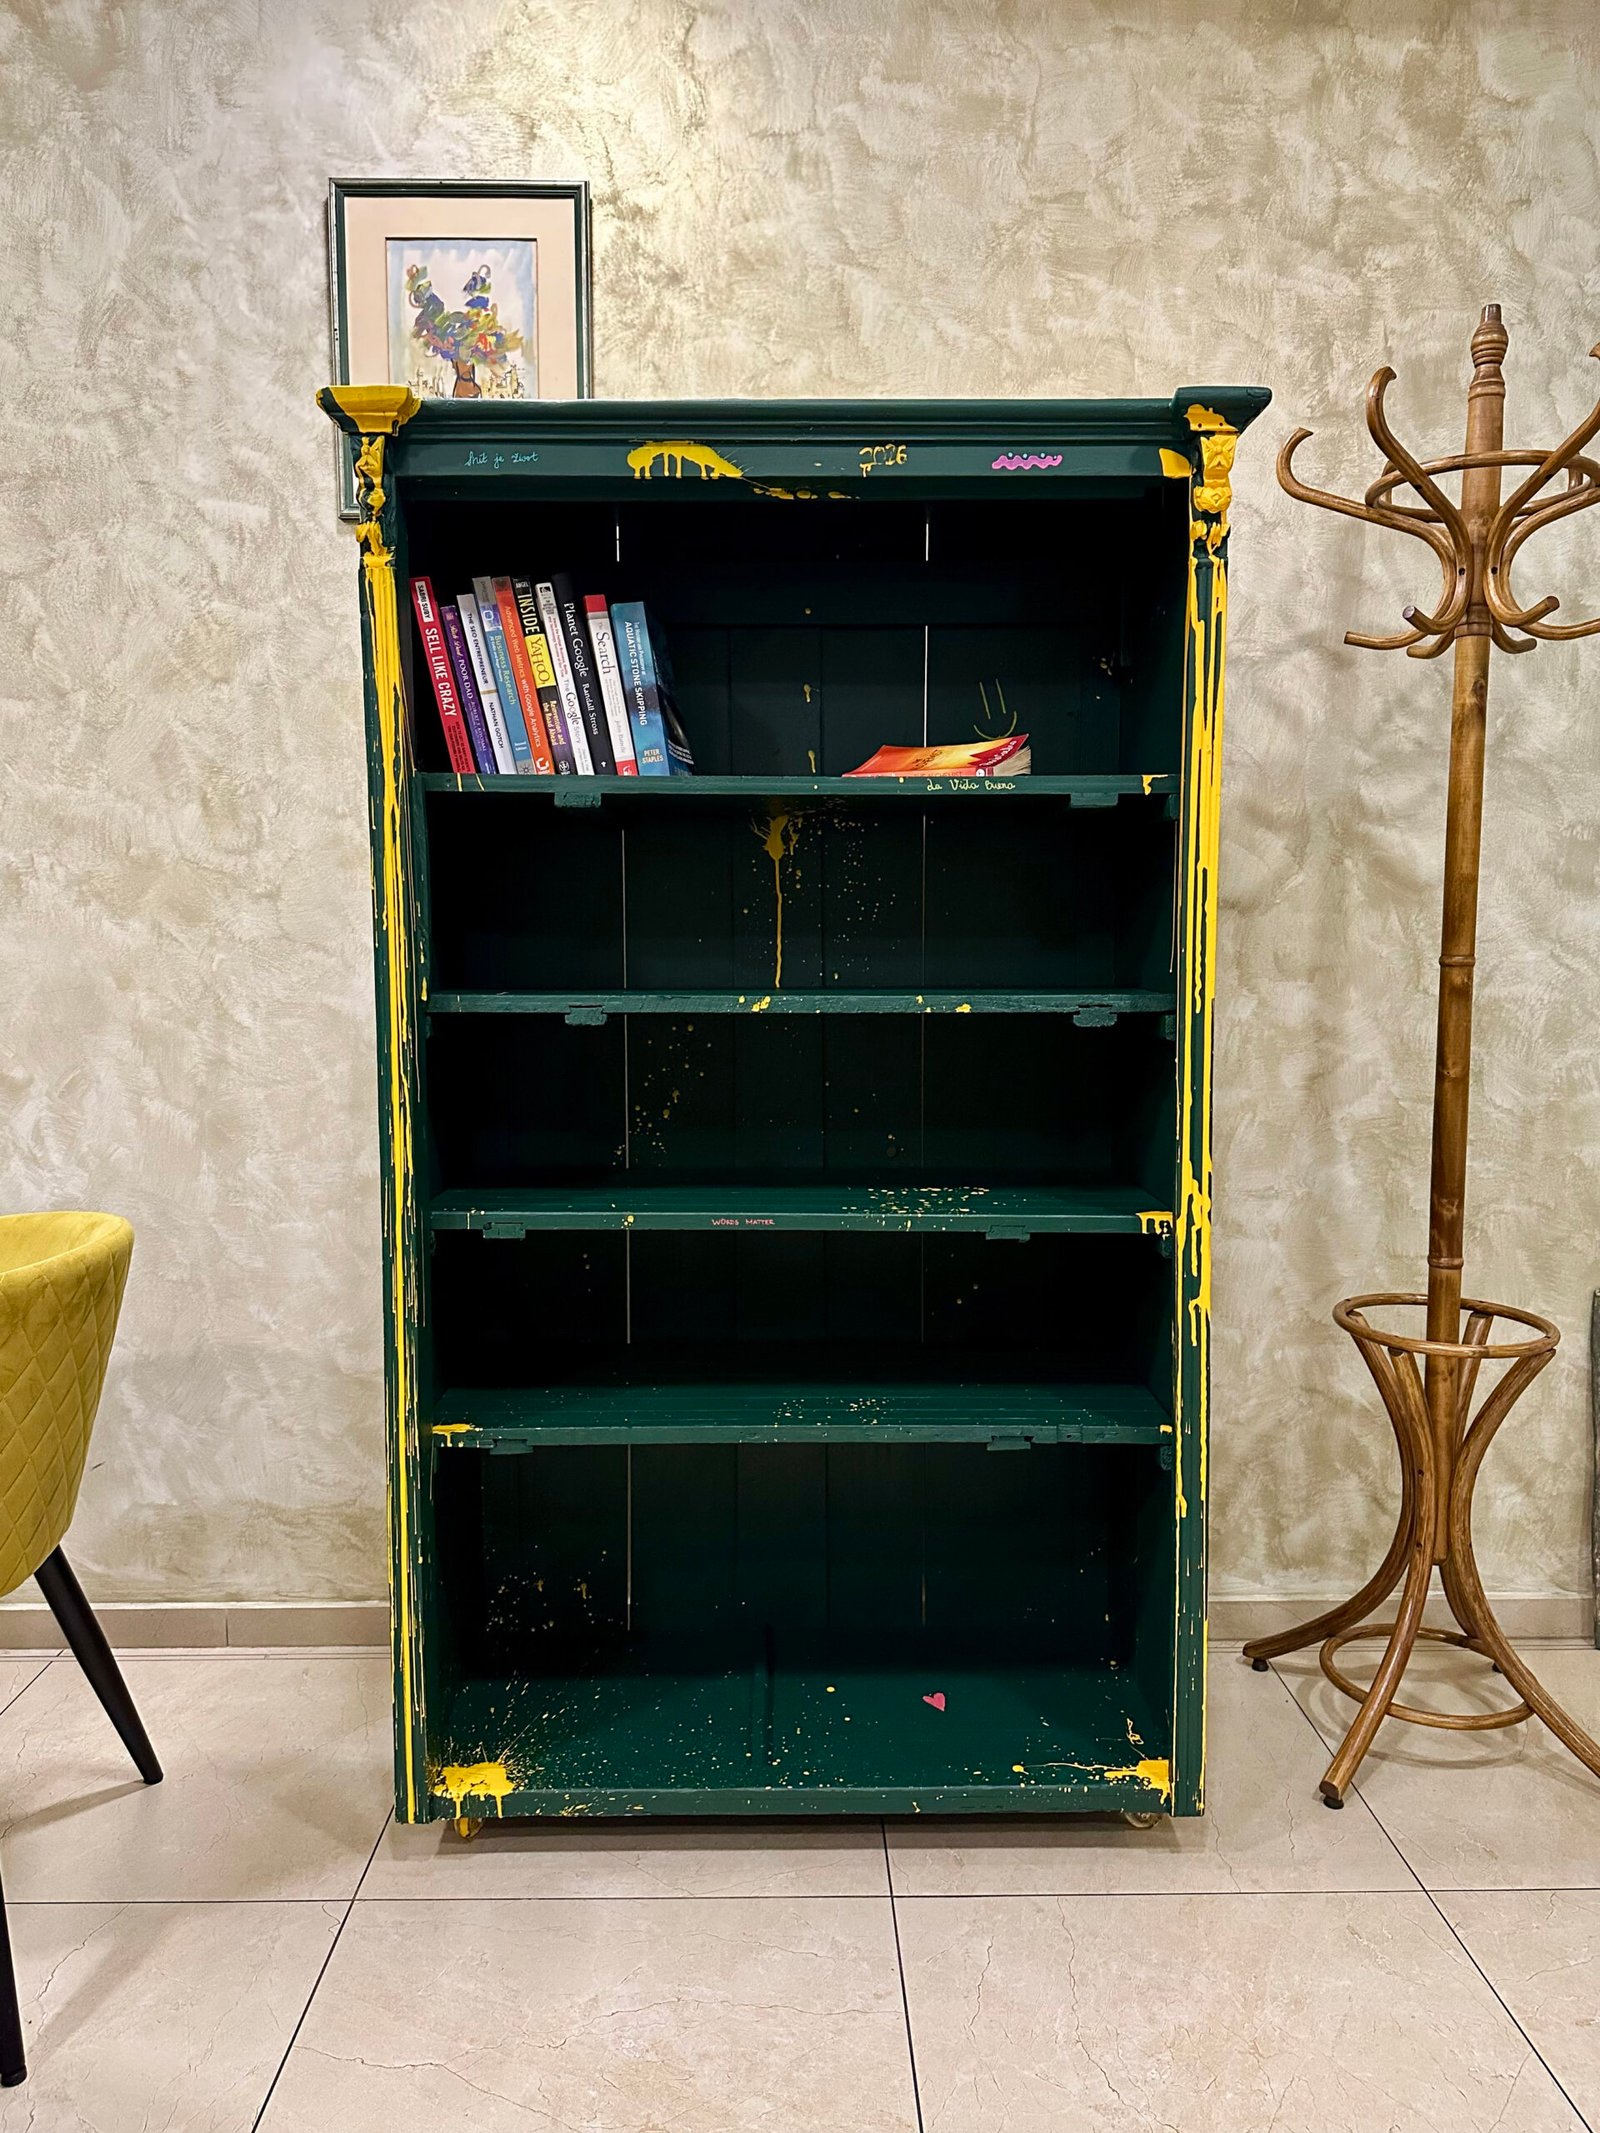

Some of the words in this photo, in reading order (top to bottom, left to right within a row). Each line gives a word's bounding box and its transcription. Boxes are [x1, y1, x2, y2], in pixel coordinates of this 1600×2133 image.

[417, 584, 427, 603] SABRI
[422, 602, 431, 619] SUBY
[517, 594, 540, 634] INSIDE
[505, 606, 518, 639] Advanced
[425, 627, 442, 654] SELL
[512, 639, 520, 654] Web
[563, 602, 579, 637] Planet
[572, 638, 589, 677] Google
[595, 631, 615, 675] Search
[624, 621, 637, 658] AQUATIC
[431, 655, 448, 680] LIKE
[458, 659, 469, 680] POOR
[473, 639, 489, 685] ENTREPRENEUR
[495, 635, 507, 669] Business
[502, 670, 516, 705] Research
[516, 654, 525, 678] Metrics
[630, 658, 642, 687] STONE
[437, 681, 458, 717] CRAZY
[463, 681, 474, 699] DAD
[521, 678, 529, 694] with
[582, 683, 595, 711] Randall
[524, 694, 535, 717] Google
[565, 691, 581, 726] Google
[634, 687, 648, 726] SKIPPING
[489, 702, 498, 727] NATHAN
[495, 727, 504, 749] GOTCH
[530, 717, 541, 747] Analytics
[545, 713, 554, 728] Road
[550, 700, 562, 734] Reinvention
[558, 734, 567, 745] and
[588, 712, 599, 736] Stross
[548, 728, 558, 746] Ahead
[641, 754, 664, 764] STAPLES
[643, 748, 660, 757] PETER
[949, 778, 980, 791] Vida
[984, 779, 1016, 791] Buena
[711, 1218, 740, 1226] WORDS
[745, 1218, 776, 1226] MATTER
